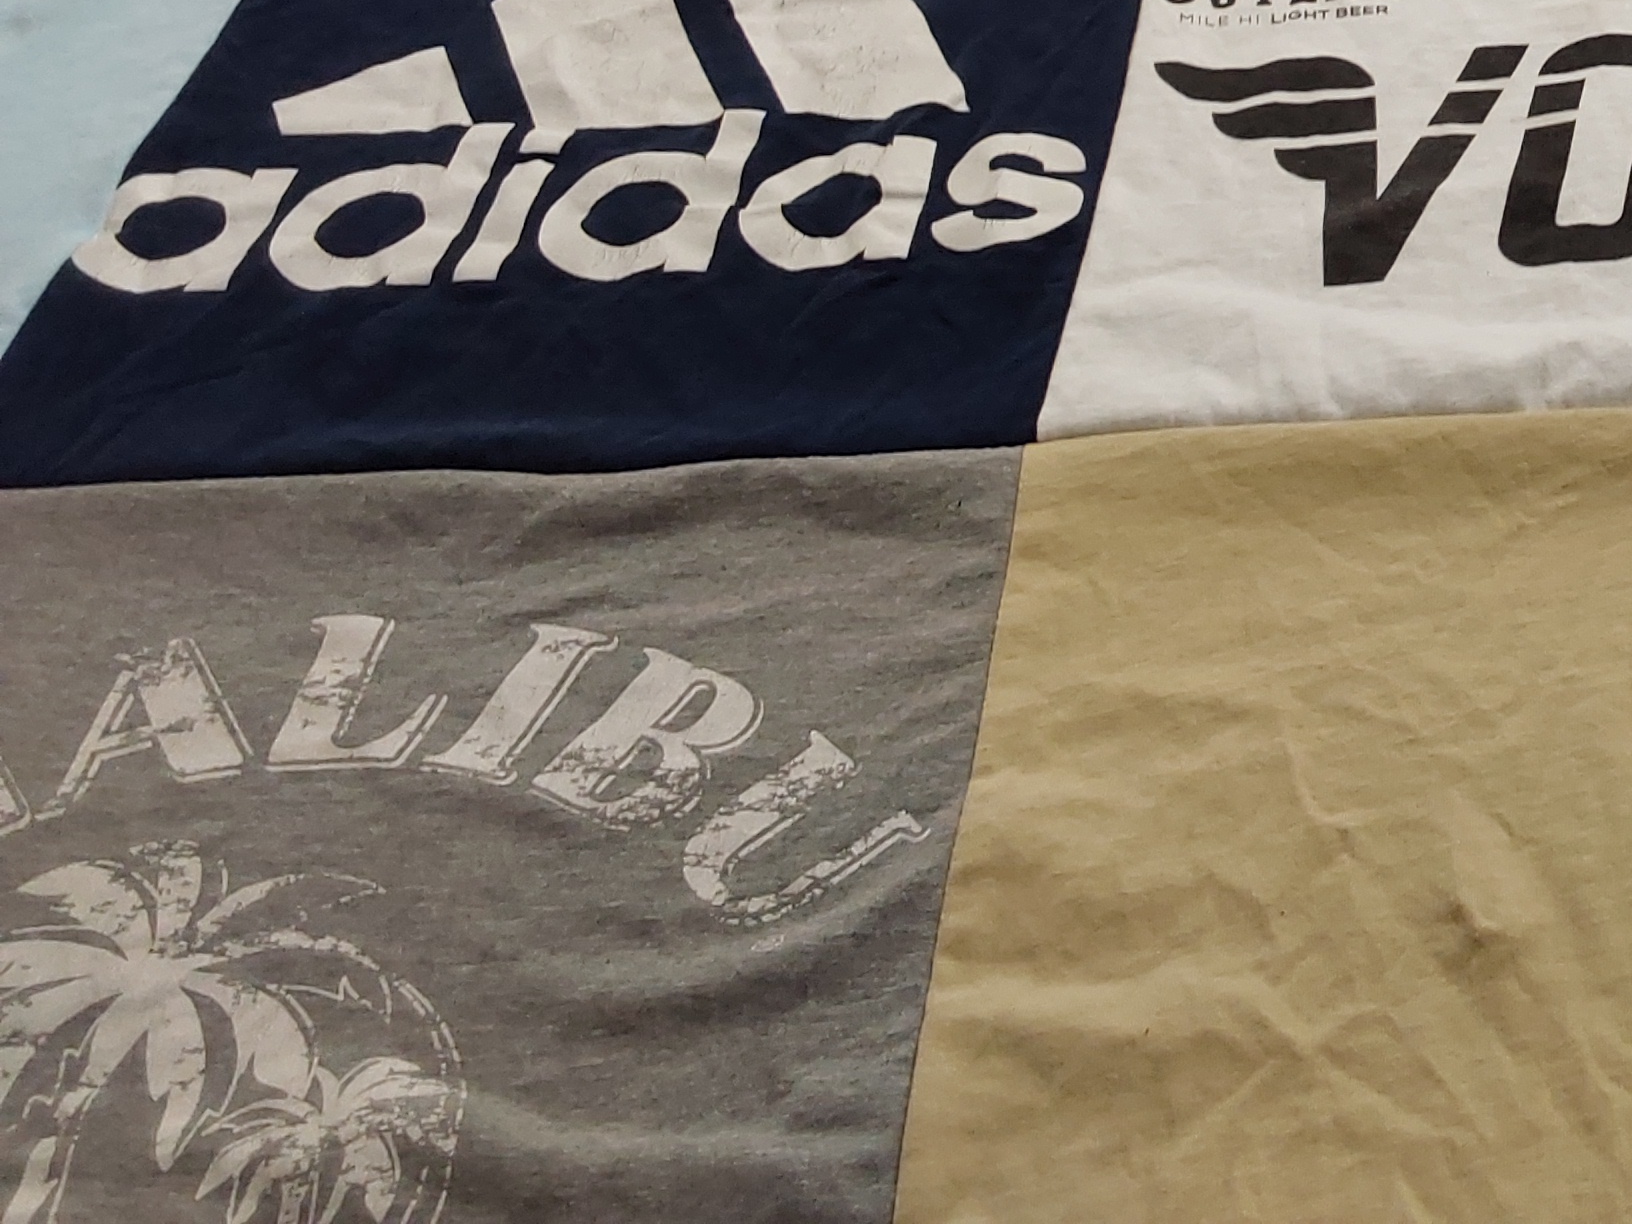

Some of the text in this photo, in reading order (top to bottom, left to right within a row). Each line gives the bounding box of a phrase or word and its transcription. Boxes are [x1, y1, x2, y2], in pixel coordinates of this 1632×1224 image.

[1179, 5, 1389, 27] MILE HI LIGHT BEER
[71, 108, 1087, 293] adidas
[0, 614, 933, 927] ALIBU
